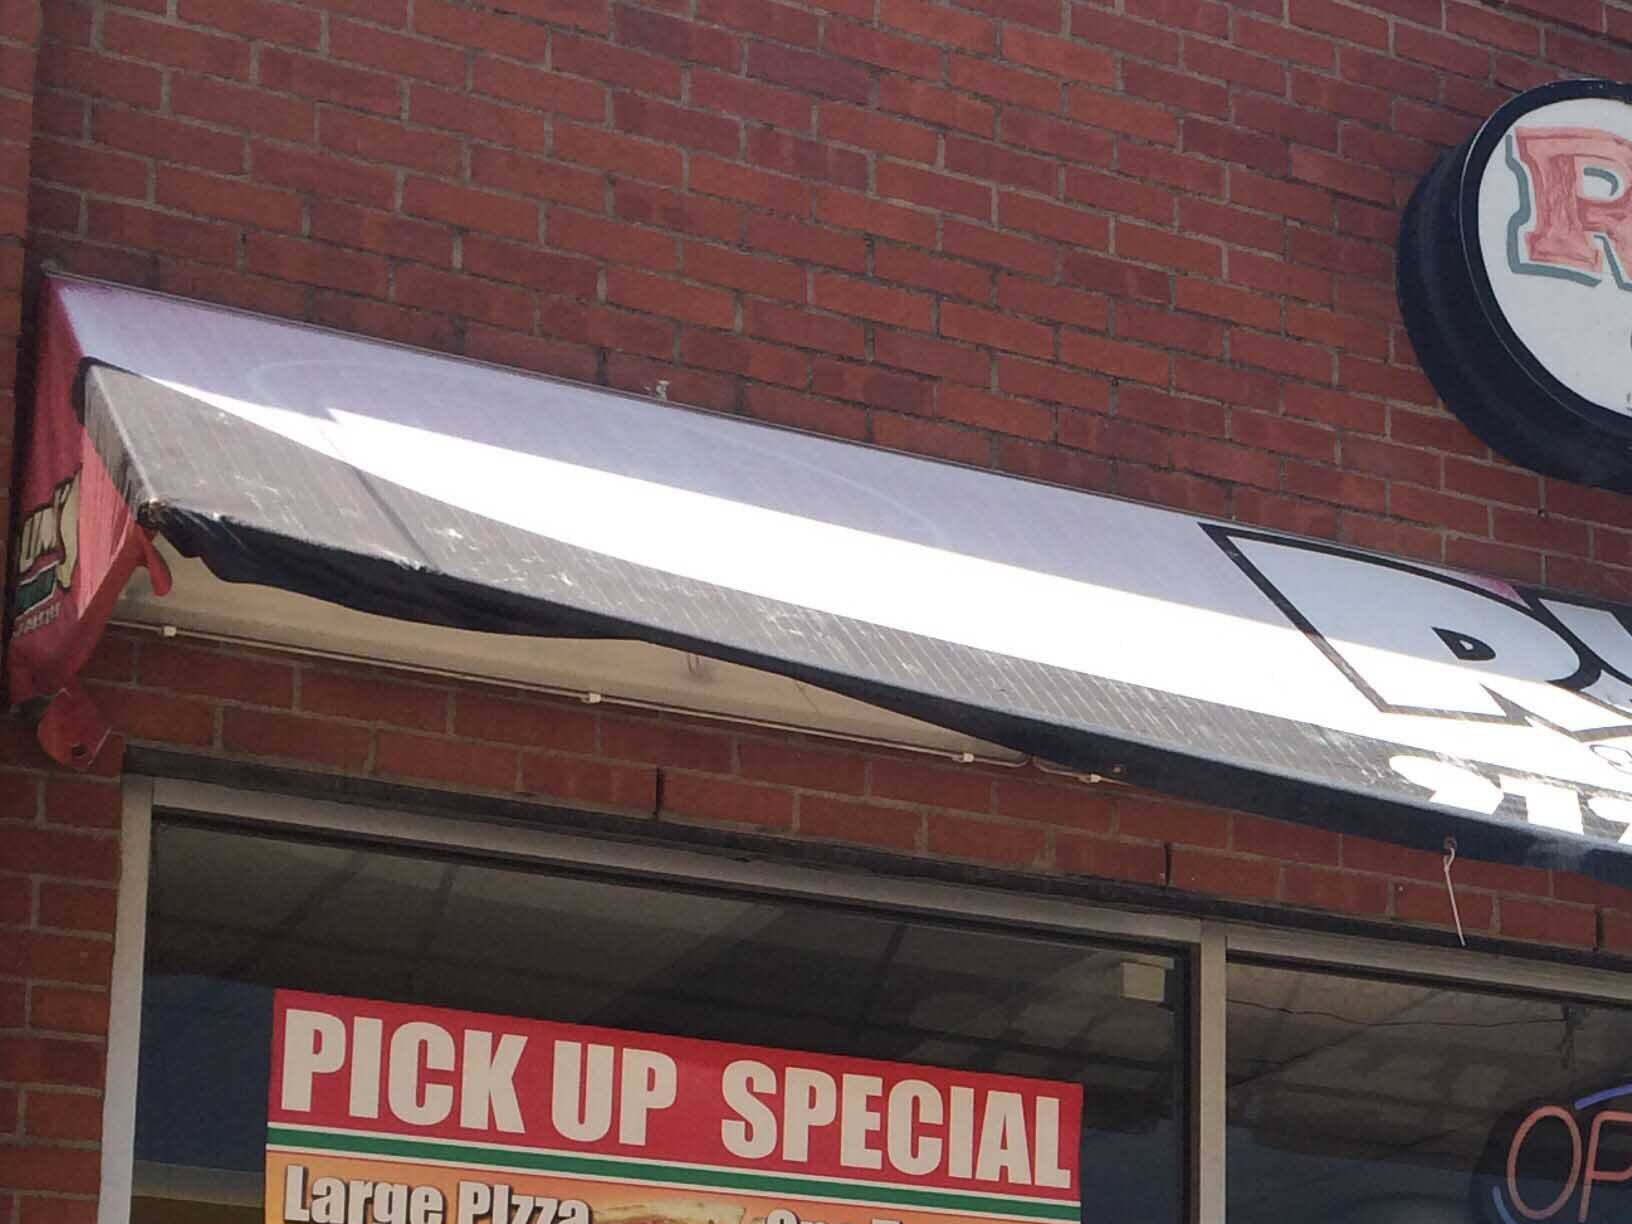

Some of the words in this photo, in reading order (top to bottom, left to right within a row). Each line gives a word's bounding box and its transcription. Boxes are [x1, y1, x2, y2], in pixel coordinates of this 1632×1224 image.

[281, 1008, 528, 1134] PICK
[552, 1040, 677, 1146] UP
[721, 1059, 1072, 1189] SPECIAL
